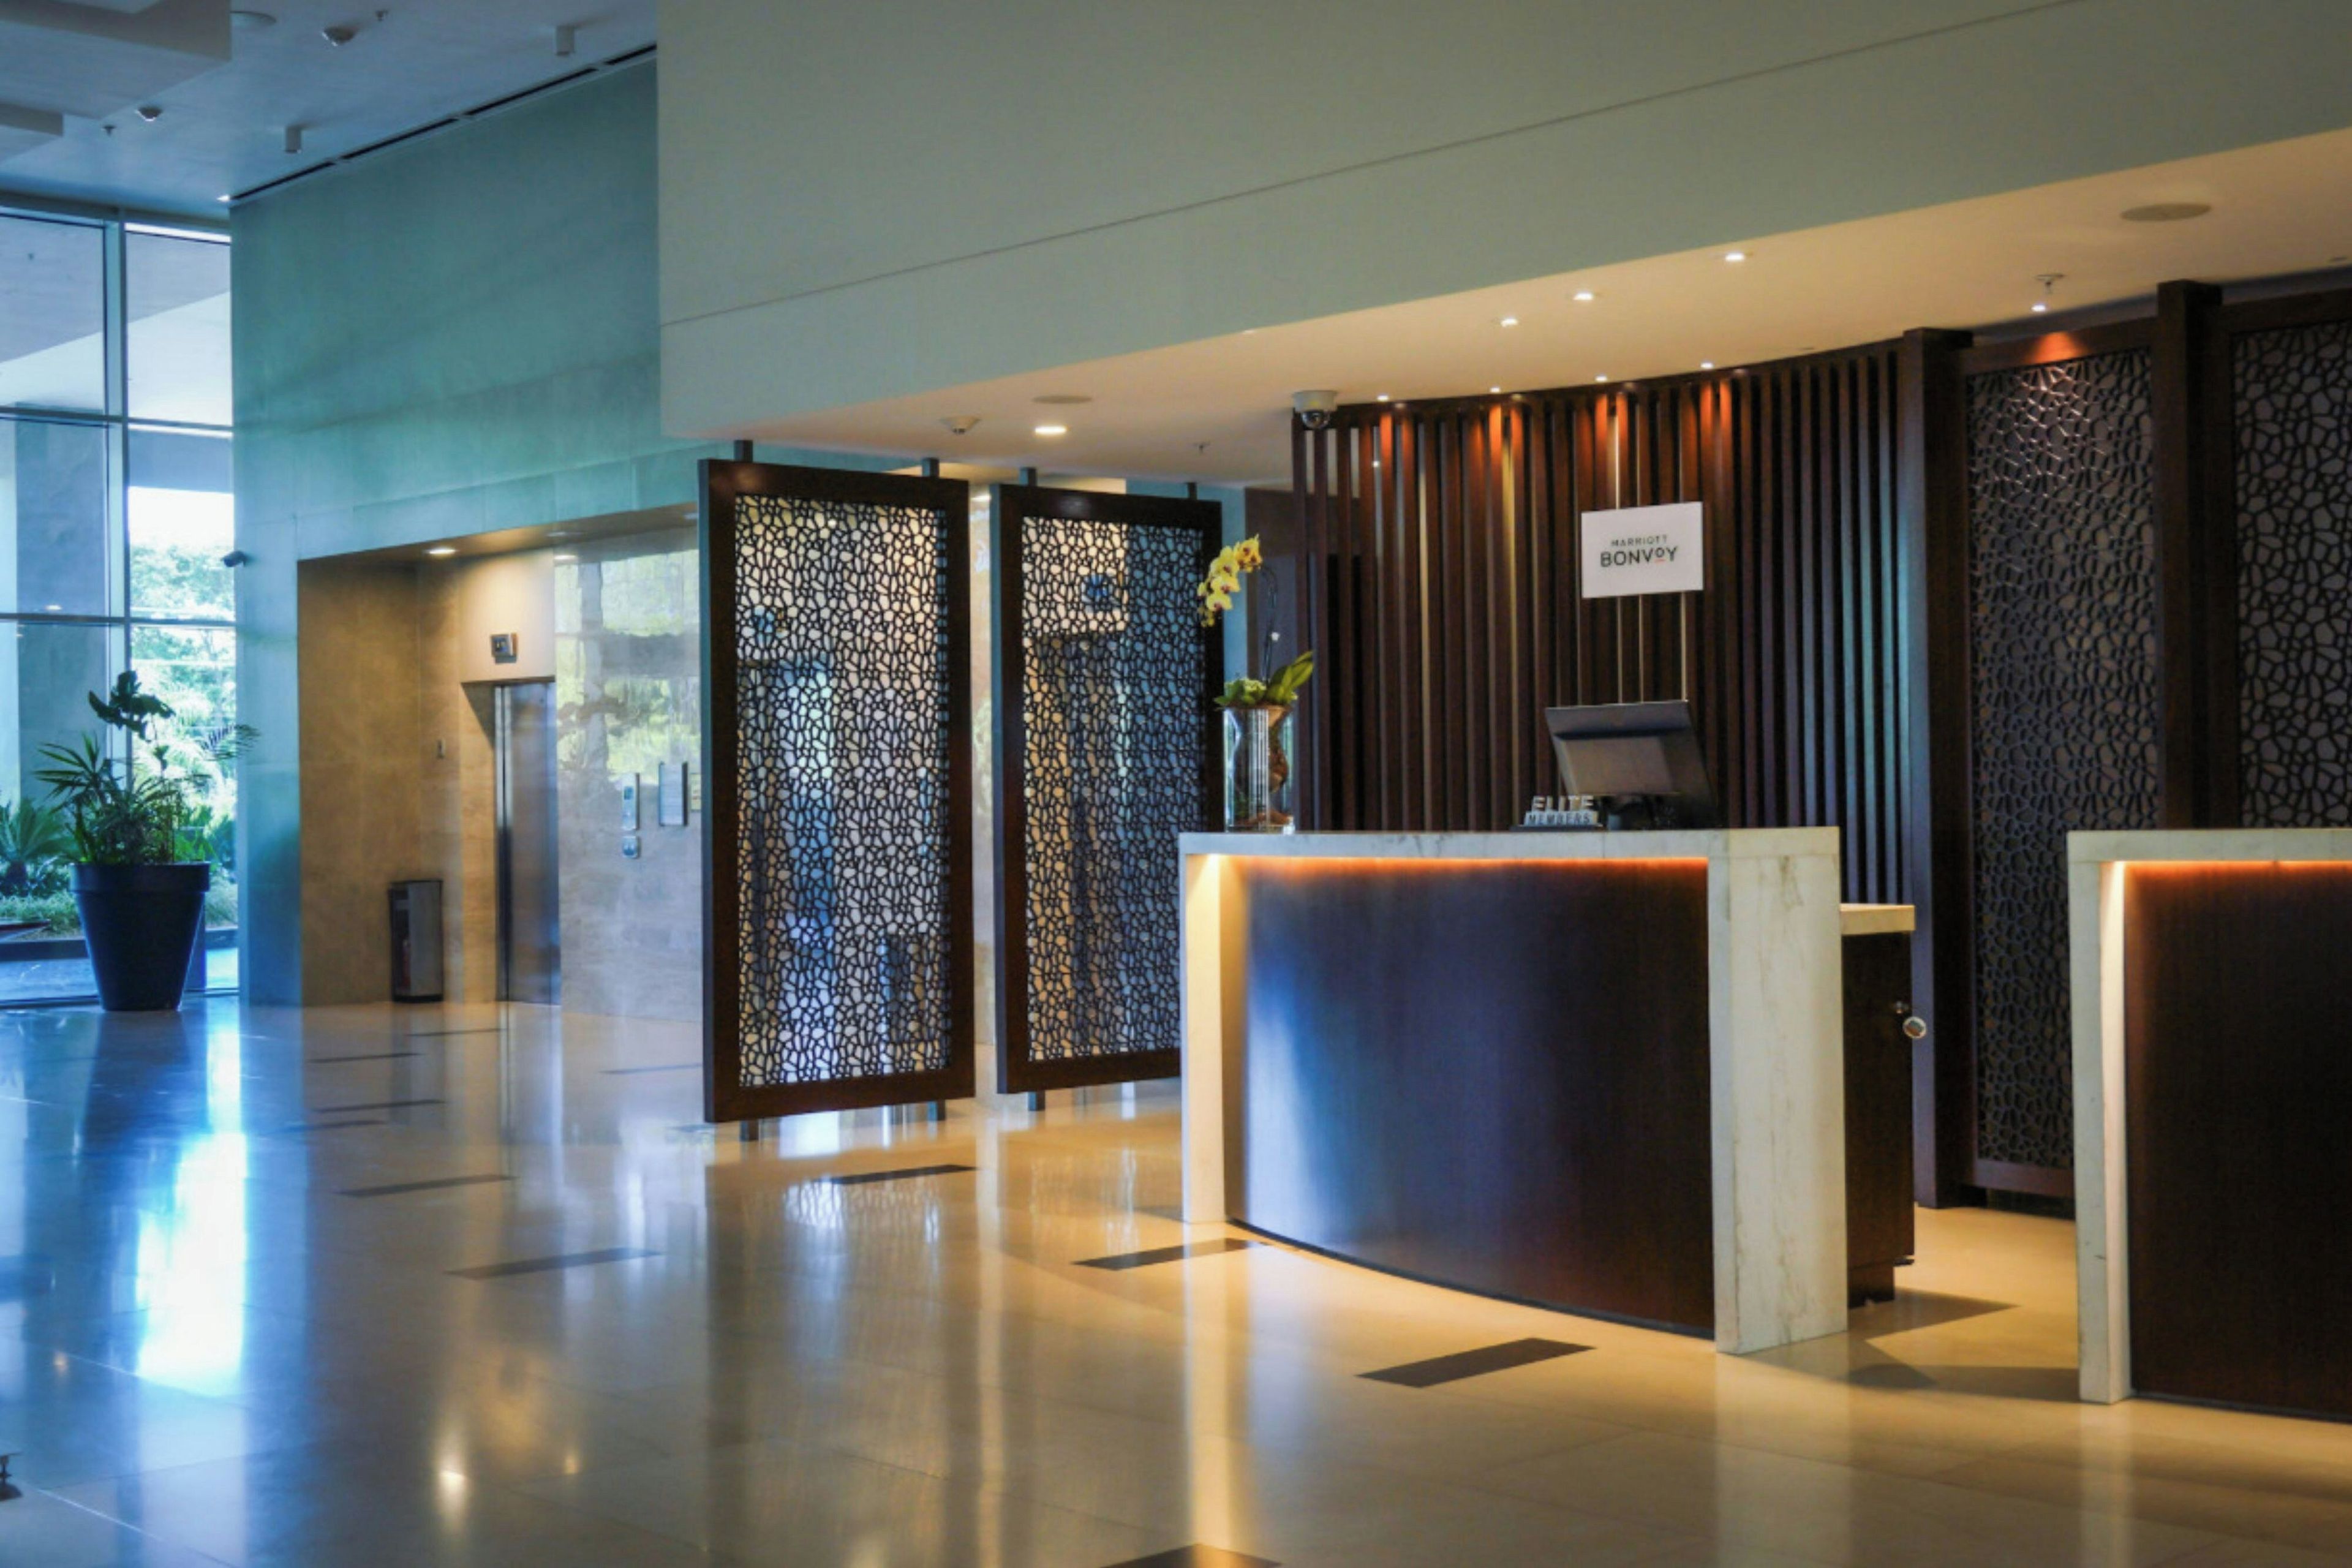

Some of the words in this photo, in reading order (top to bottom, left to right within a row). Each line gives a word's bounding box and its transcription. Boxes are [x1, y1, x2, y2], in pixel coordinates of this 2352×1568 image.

[1611, 535, 1668, 547] MARRIOTT
[1600, 546, 1678, 567] BONVOY
[1531, 795, 1594, 812] ELITE
